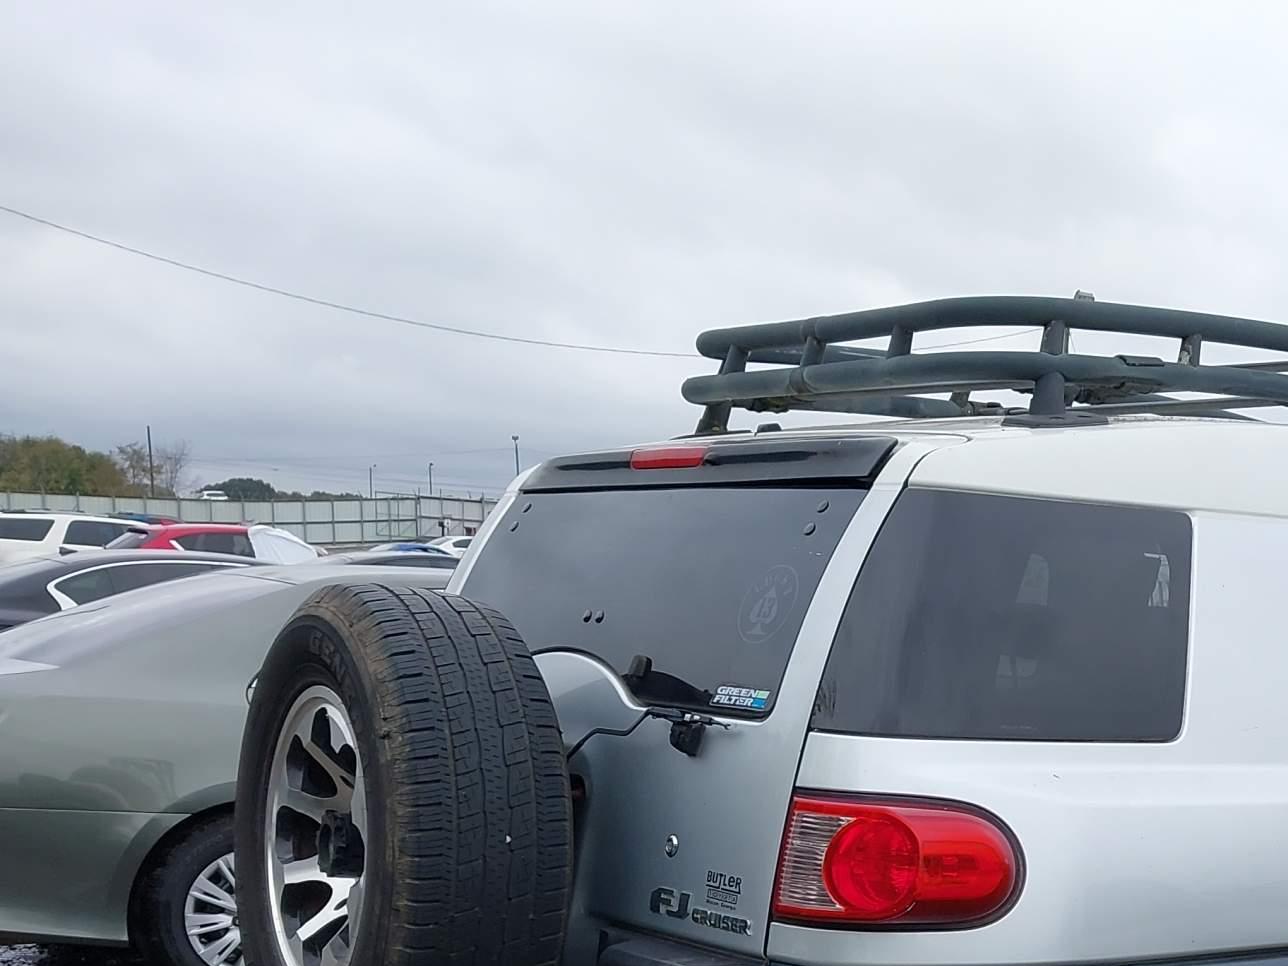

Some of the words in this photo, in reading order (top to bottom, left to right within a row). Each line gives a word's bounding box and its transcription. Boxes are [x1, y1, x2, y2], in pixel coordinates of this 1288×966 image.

[712, 695, 755, 706] FILTER
[716, 685, 760, 698] GREEN
[650, 887, 692, 920] FJ
[691, 908, 752, 936] CRUISER
